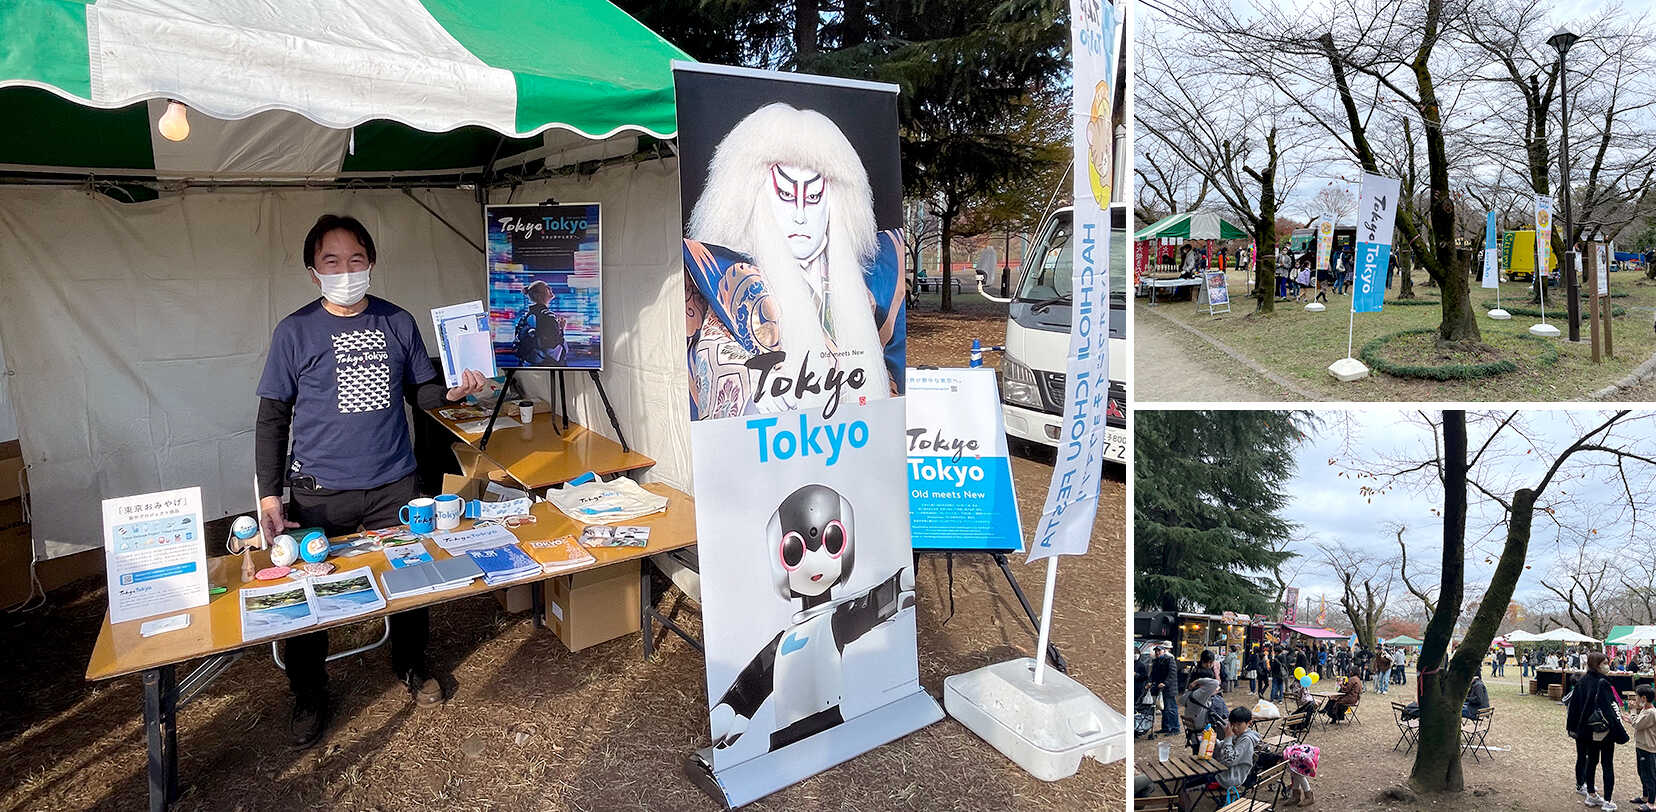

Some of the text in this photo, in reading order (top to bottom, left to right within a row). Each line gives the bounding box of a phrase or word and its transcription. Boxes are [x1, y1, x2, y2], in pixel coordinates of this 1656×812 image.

[498, 216, 588, 240] Tokyo Tokyo
[1364, 194, 1387, 242] Tokyo
[1361, 244, 1380, 294] Tokyo
[335, 351, 389, 367] Tokyo Tokyo
[743, 350, 867, 420] Tokyo
[746, 413, 869, 467] Tokyo
[906, 427, 980, 464] Tokyo
[907, 458, 985, 488] Tokyo
[911, 489, 985, 499] Old meets New
